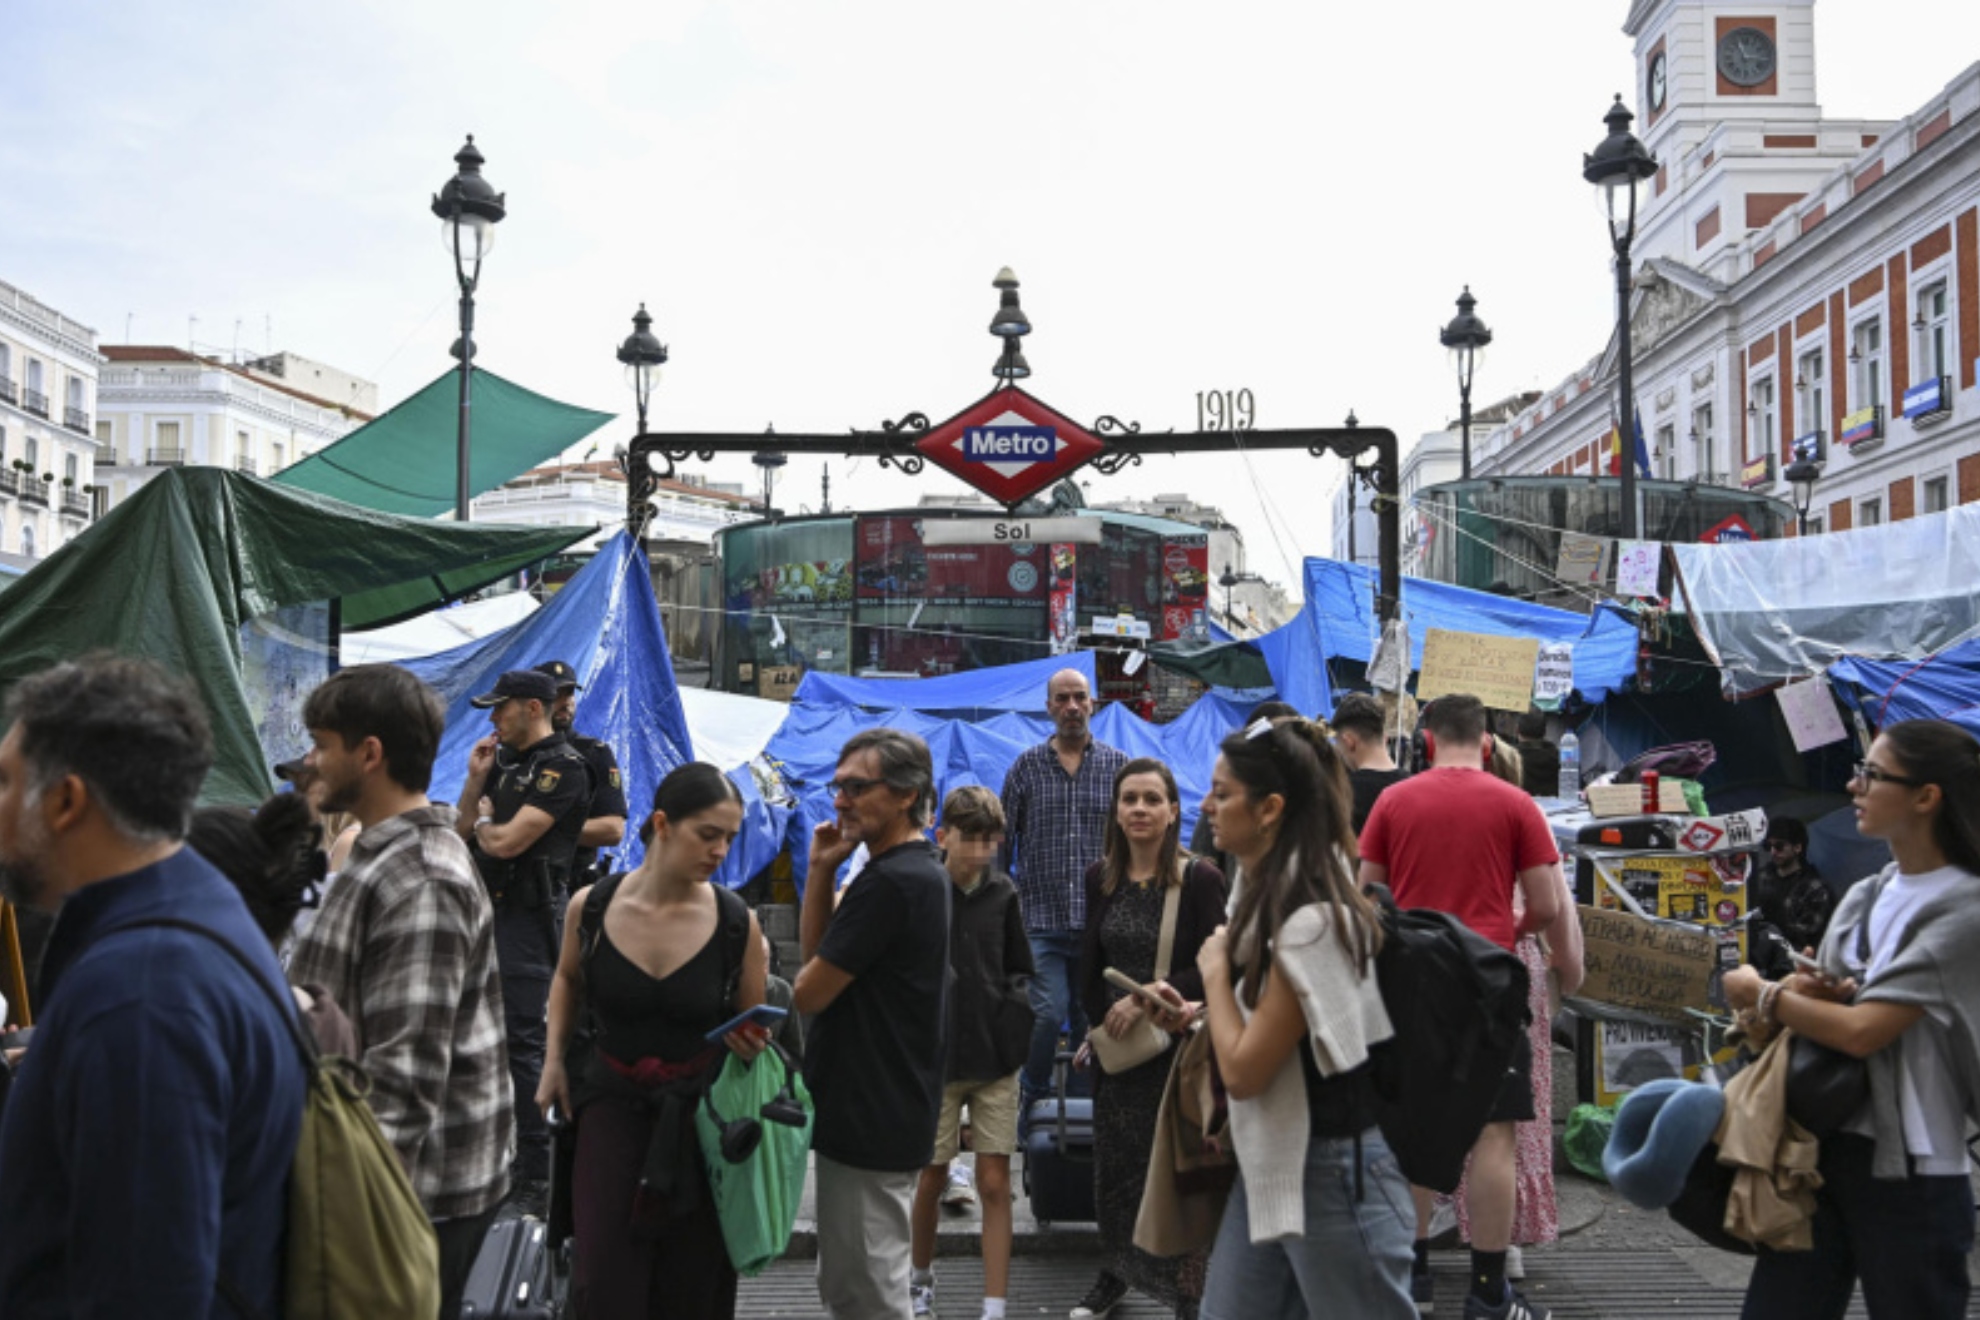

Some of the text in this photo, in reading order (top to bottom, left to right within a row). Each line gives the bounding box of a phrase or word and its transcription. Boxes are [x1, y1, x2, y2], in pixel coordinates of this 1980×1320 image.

[1196, 388, 1256, 432] 1919
[971, 430, 1049, 455] Metro
[993, 523, 1031, 540] Sol
